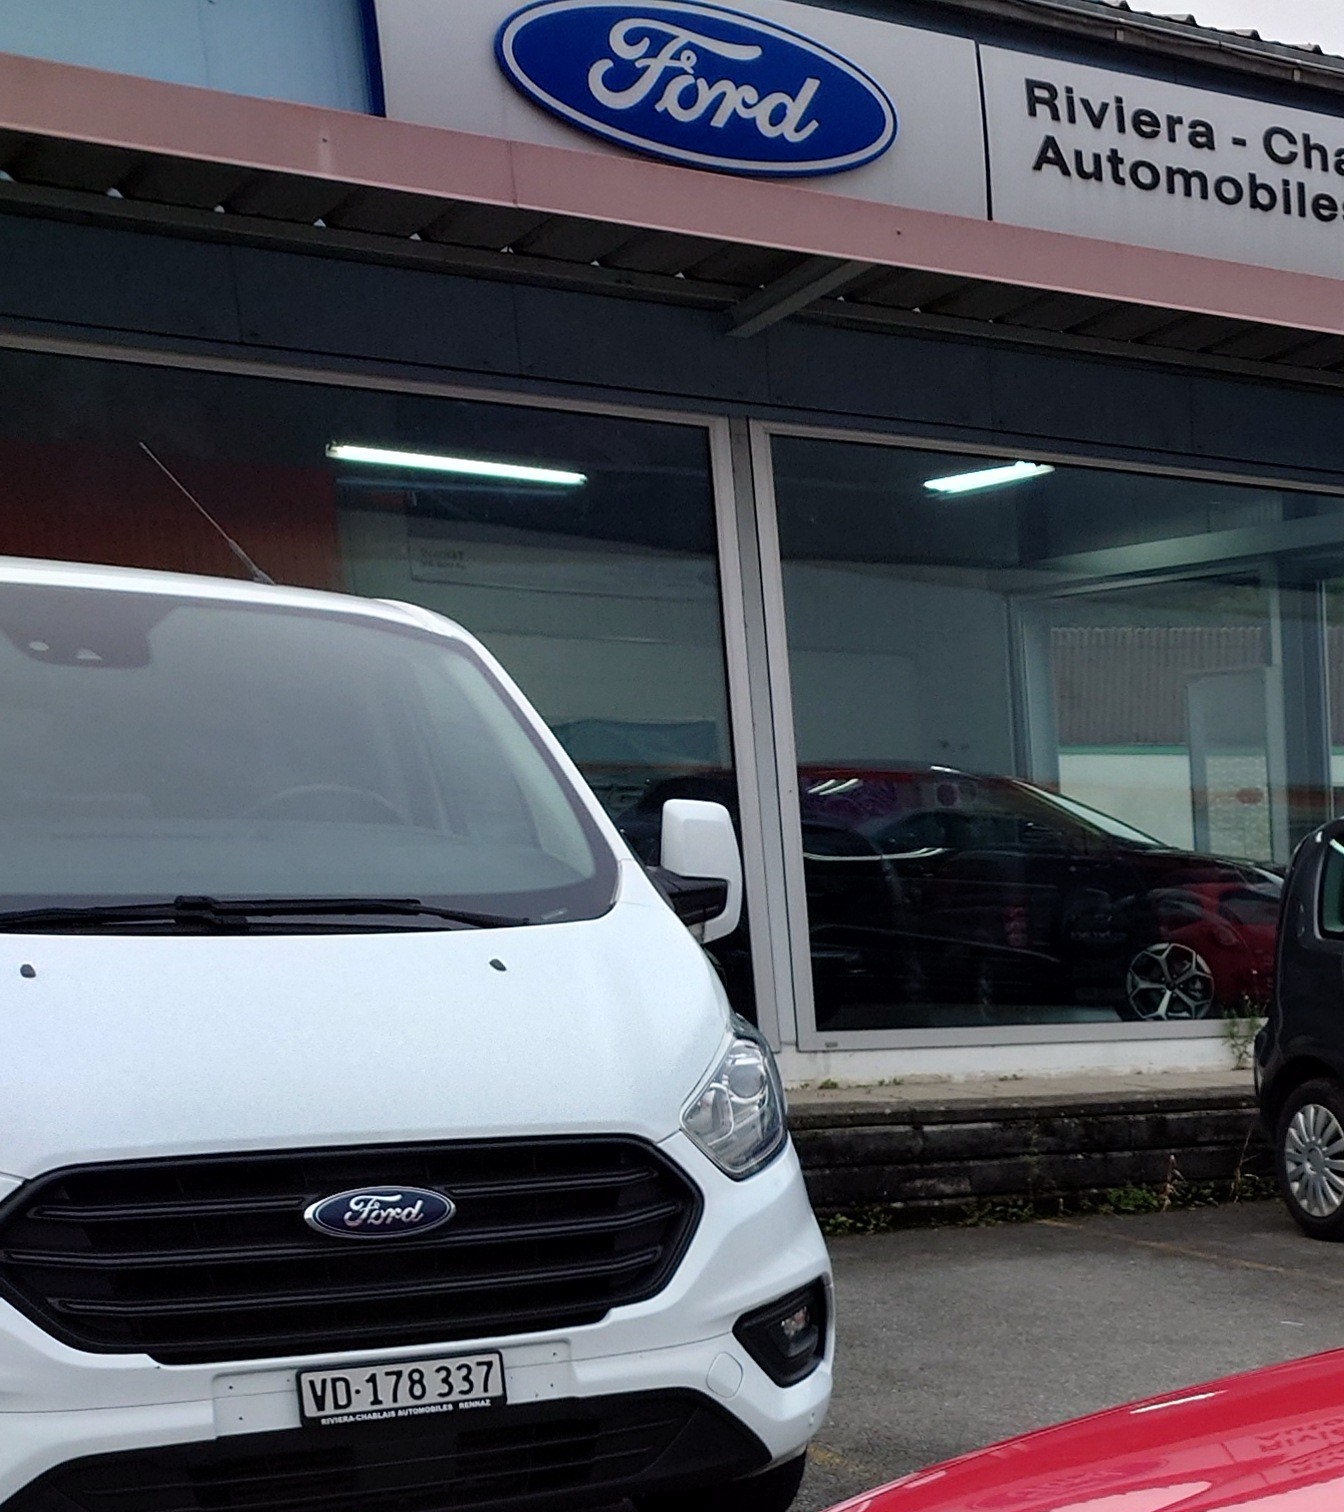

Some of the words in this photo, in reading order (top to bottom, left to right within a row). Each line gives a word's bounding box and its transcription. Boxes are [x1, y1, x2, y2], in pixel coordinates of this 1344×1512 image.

[588, 17, 820, 143] Ford
[1024, 77, 1216, 151] Riviera
[343, 1194, 424, 1227] Ford
[434, 1361, 494, 1398] 337
[397, 1403, 453, 1418] AUTOMOBILES
[458, 1399, 492, 1410] RENNAZ
